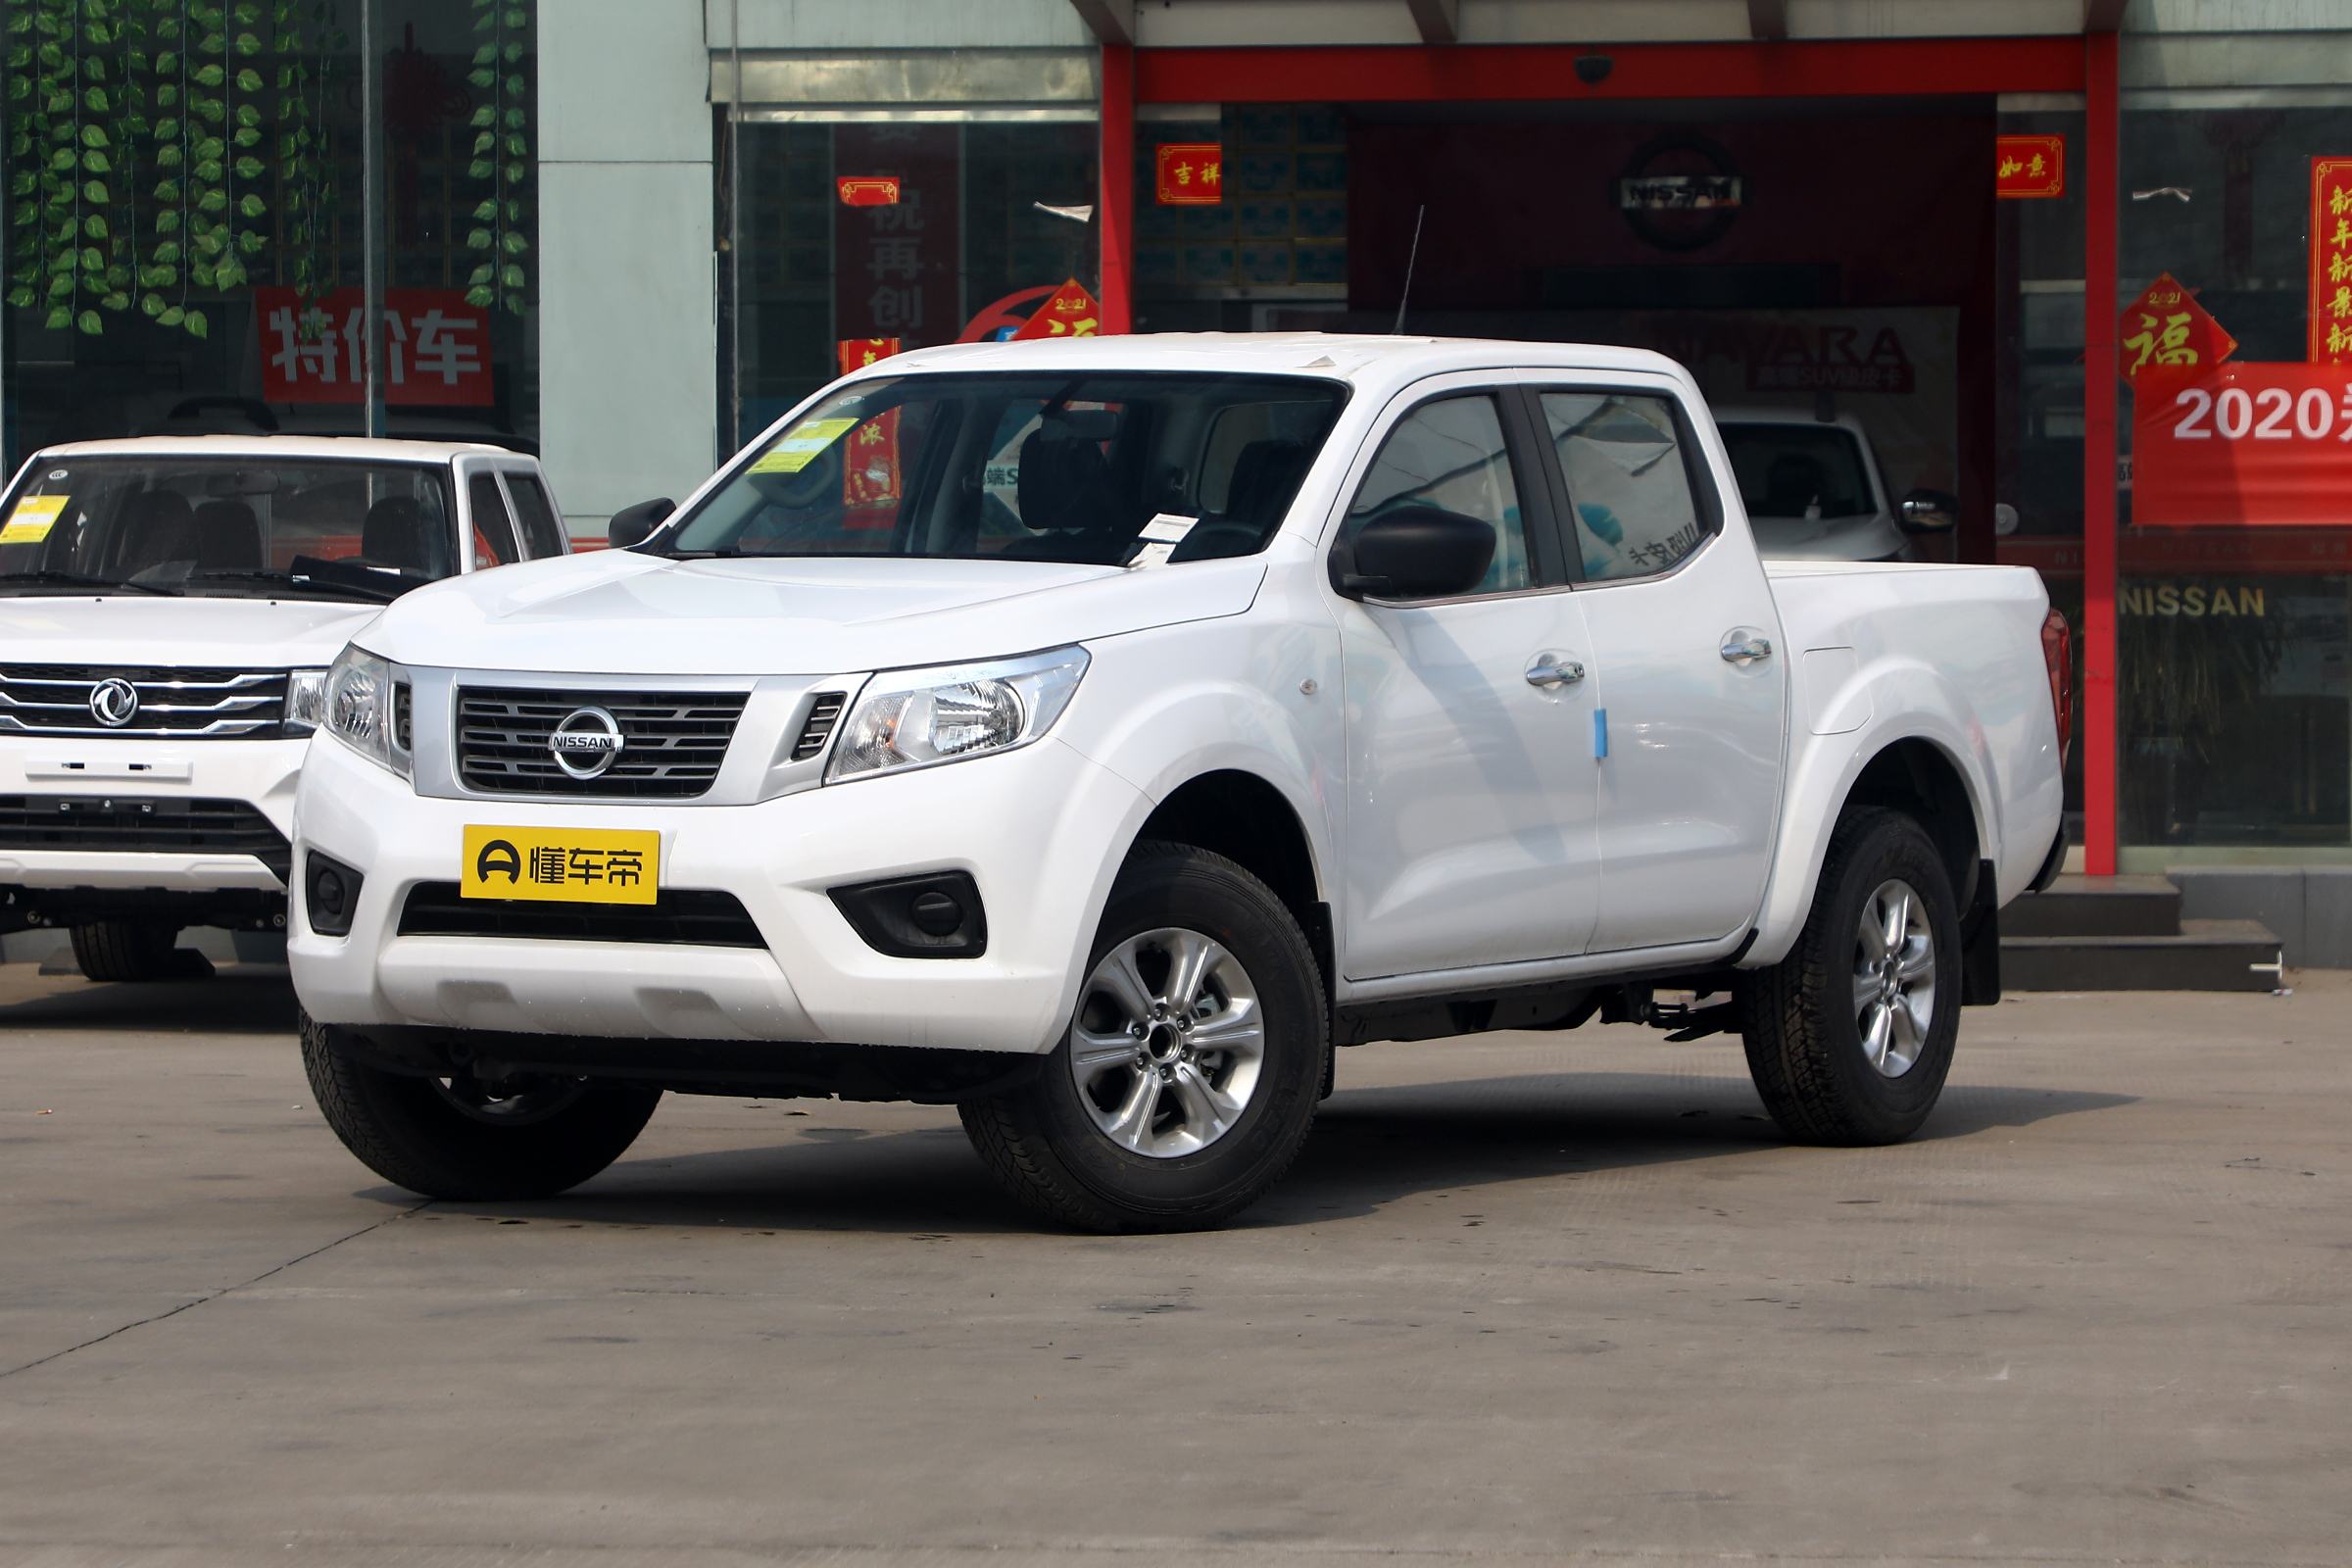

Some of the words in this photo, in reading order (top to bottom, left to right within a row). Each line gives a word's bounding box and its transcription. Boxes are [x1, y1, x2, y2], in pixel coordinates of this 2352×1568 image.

[1174, 161, 1221, 186] 吉祥
[269, 305, 481, 386] 特价车
[2123, 311, 2199, 376] 福
[2174, 387, 2352, 442] 2020
[2118, 586, 2266, 618] NISSAN
[552, 736, 614, 749] NISSAN
[529, 846, 644, 887] 懂车帝
